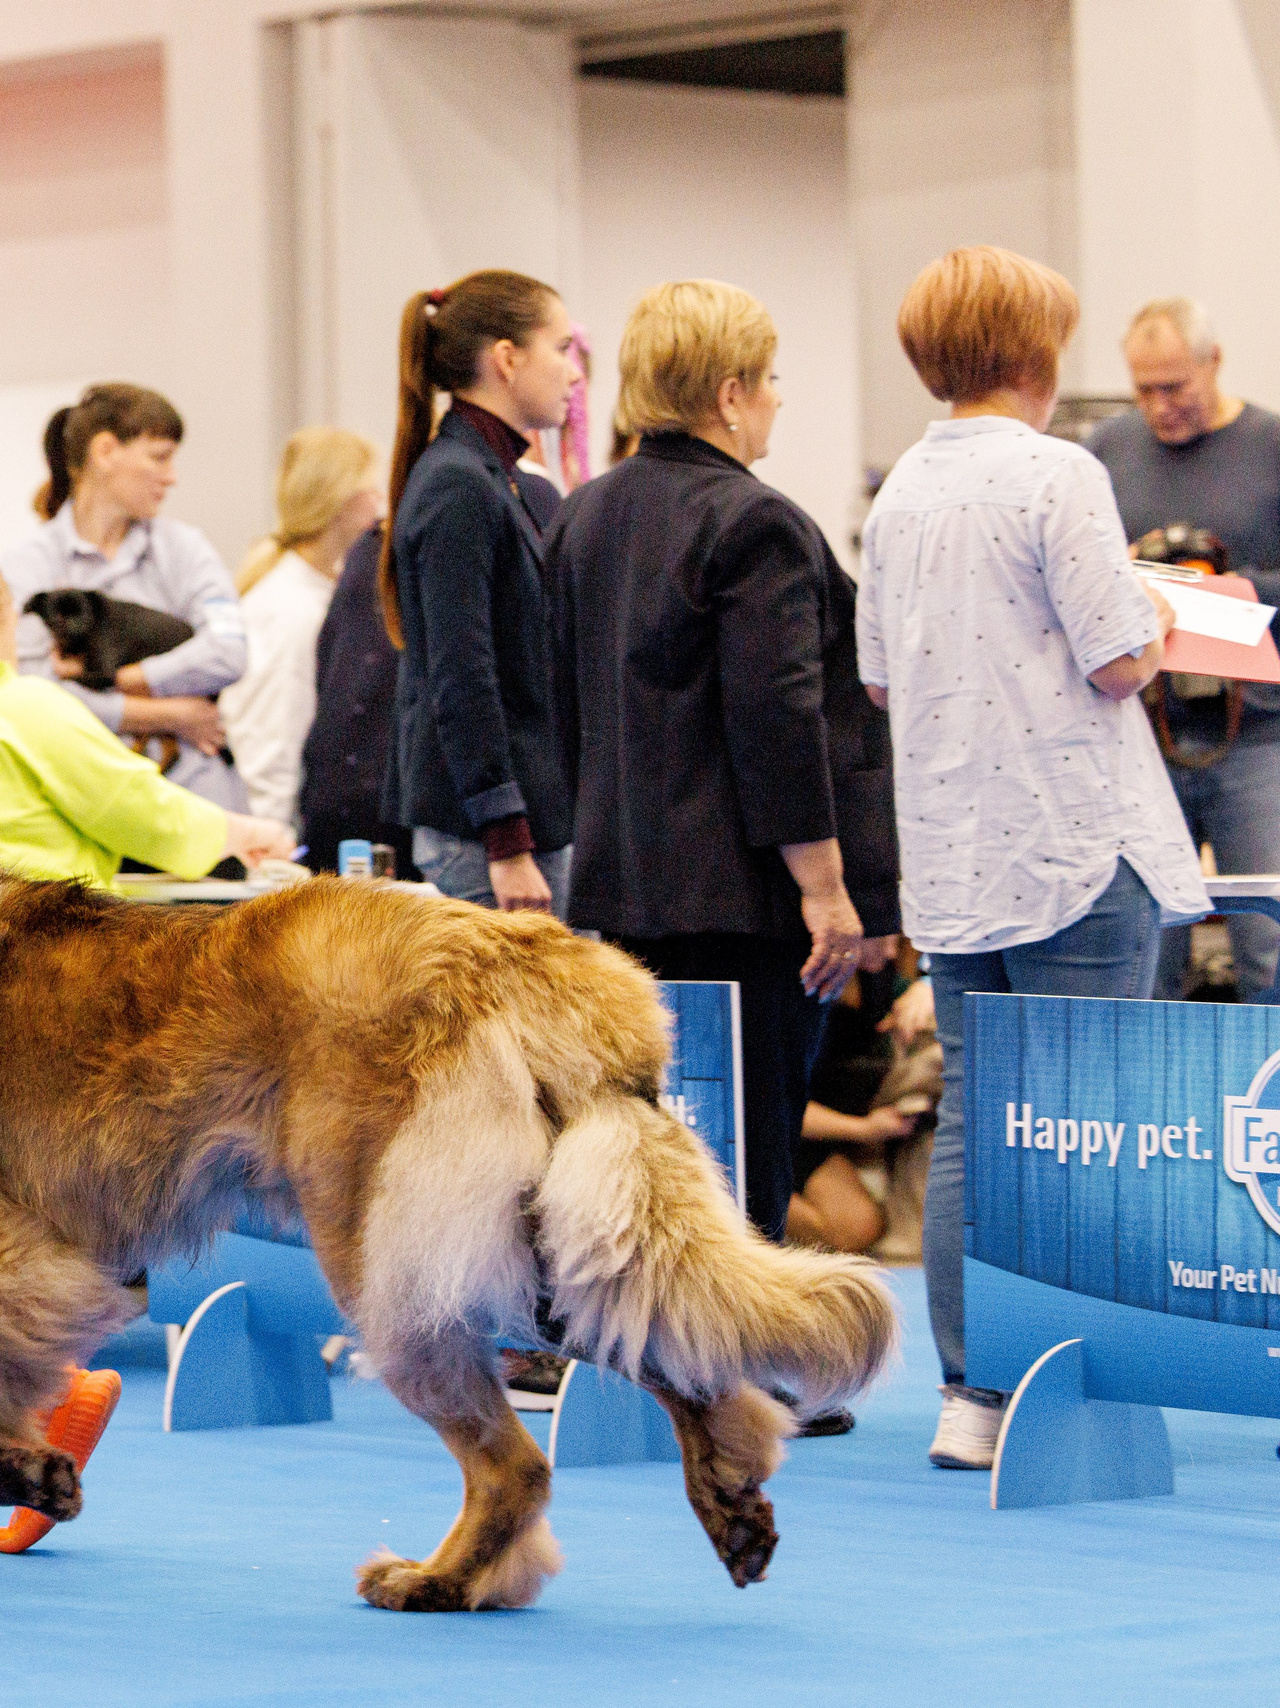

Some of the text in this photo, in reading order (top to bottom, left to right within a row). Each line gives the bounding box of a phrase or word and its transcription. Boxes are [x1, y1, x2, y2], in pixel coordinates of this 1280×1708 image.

[1006, 1102, 1213, 1170] Happy pet.
[1168, 1260, 1218, 1290] Your
[1220, 1264, 1258, 1294] Pet
